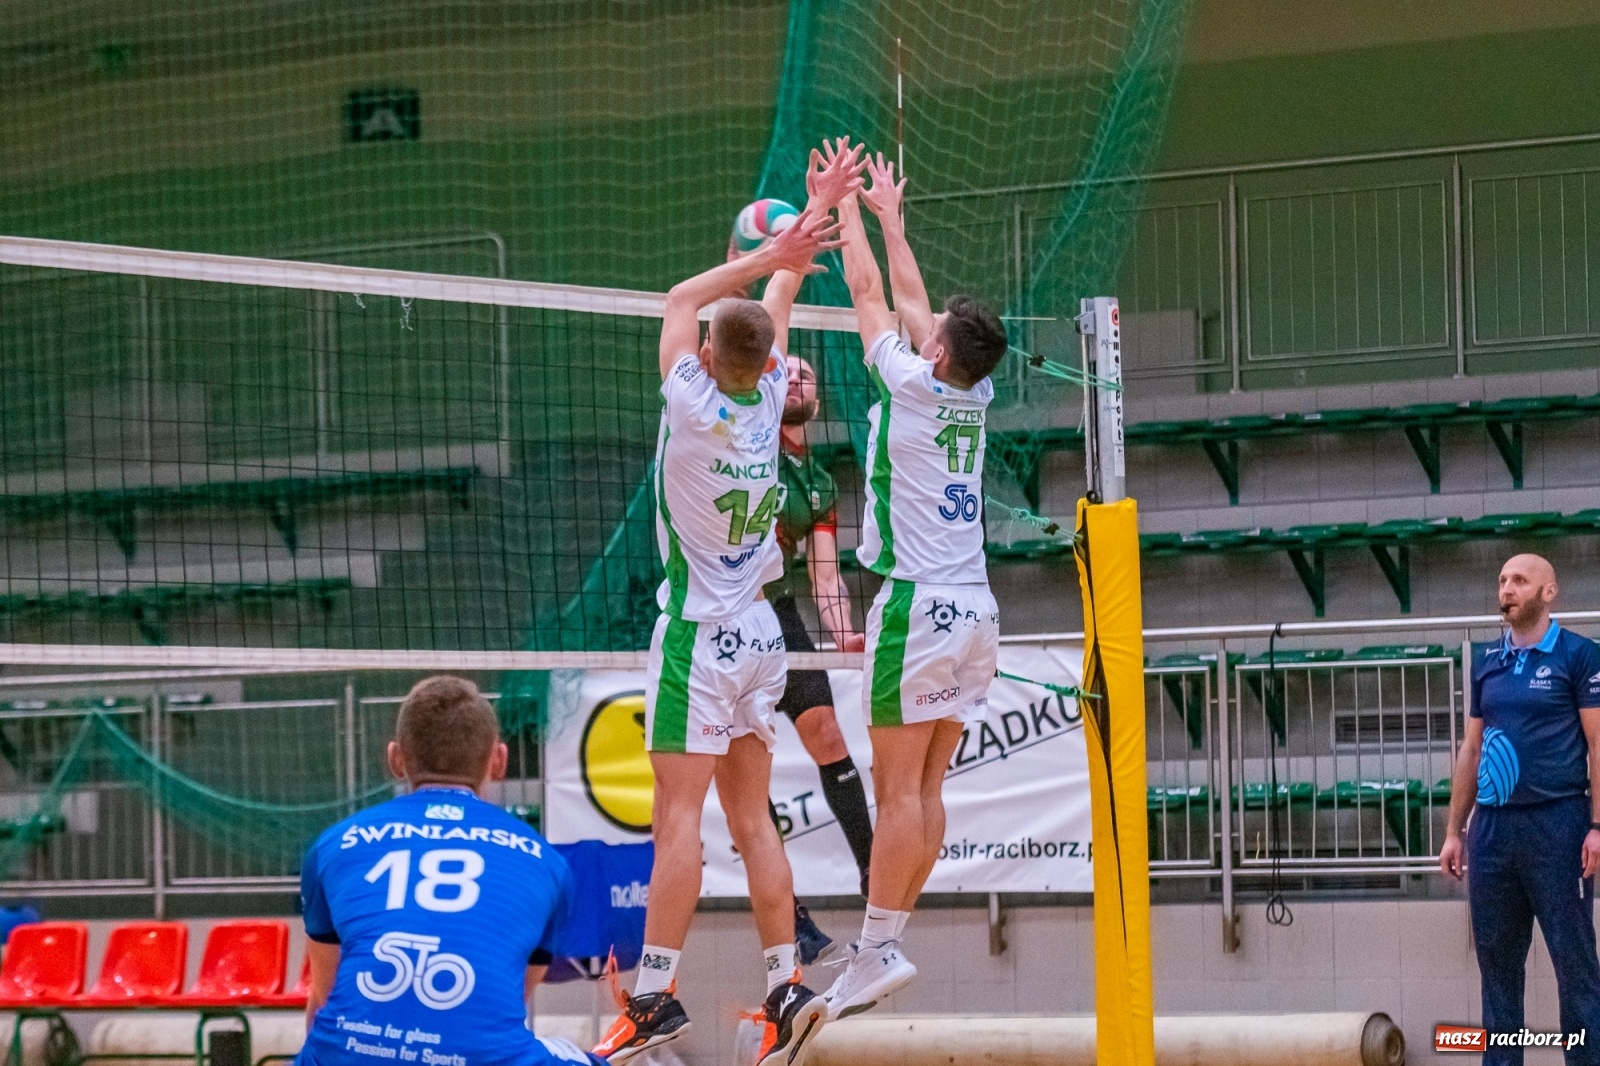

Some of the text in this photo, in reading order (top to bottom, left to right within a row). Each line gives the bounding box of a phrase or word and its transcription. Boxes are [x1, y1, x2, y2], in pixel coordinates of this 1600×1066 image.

[936, 405, 984, 424] ZACZEK
[934, 423, 982, 474] 17
[713, 483, 778, 546] 14
[916, 686, 960, 706] BTSPORT
[948, 693, 1083, 770] ZĄDKU
[340, 822, 542, 859] ŚWINIARSKI
[364, 848, 485, 913] 18
[356, 931, 476, 1011] STO
[336, 1015, 441, 1045] Passion for glass
[346, 1036, 466, 1066] Passion for Sports
